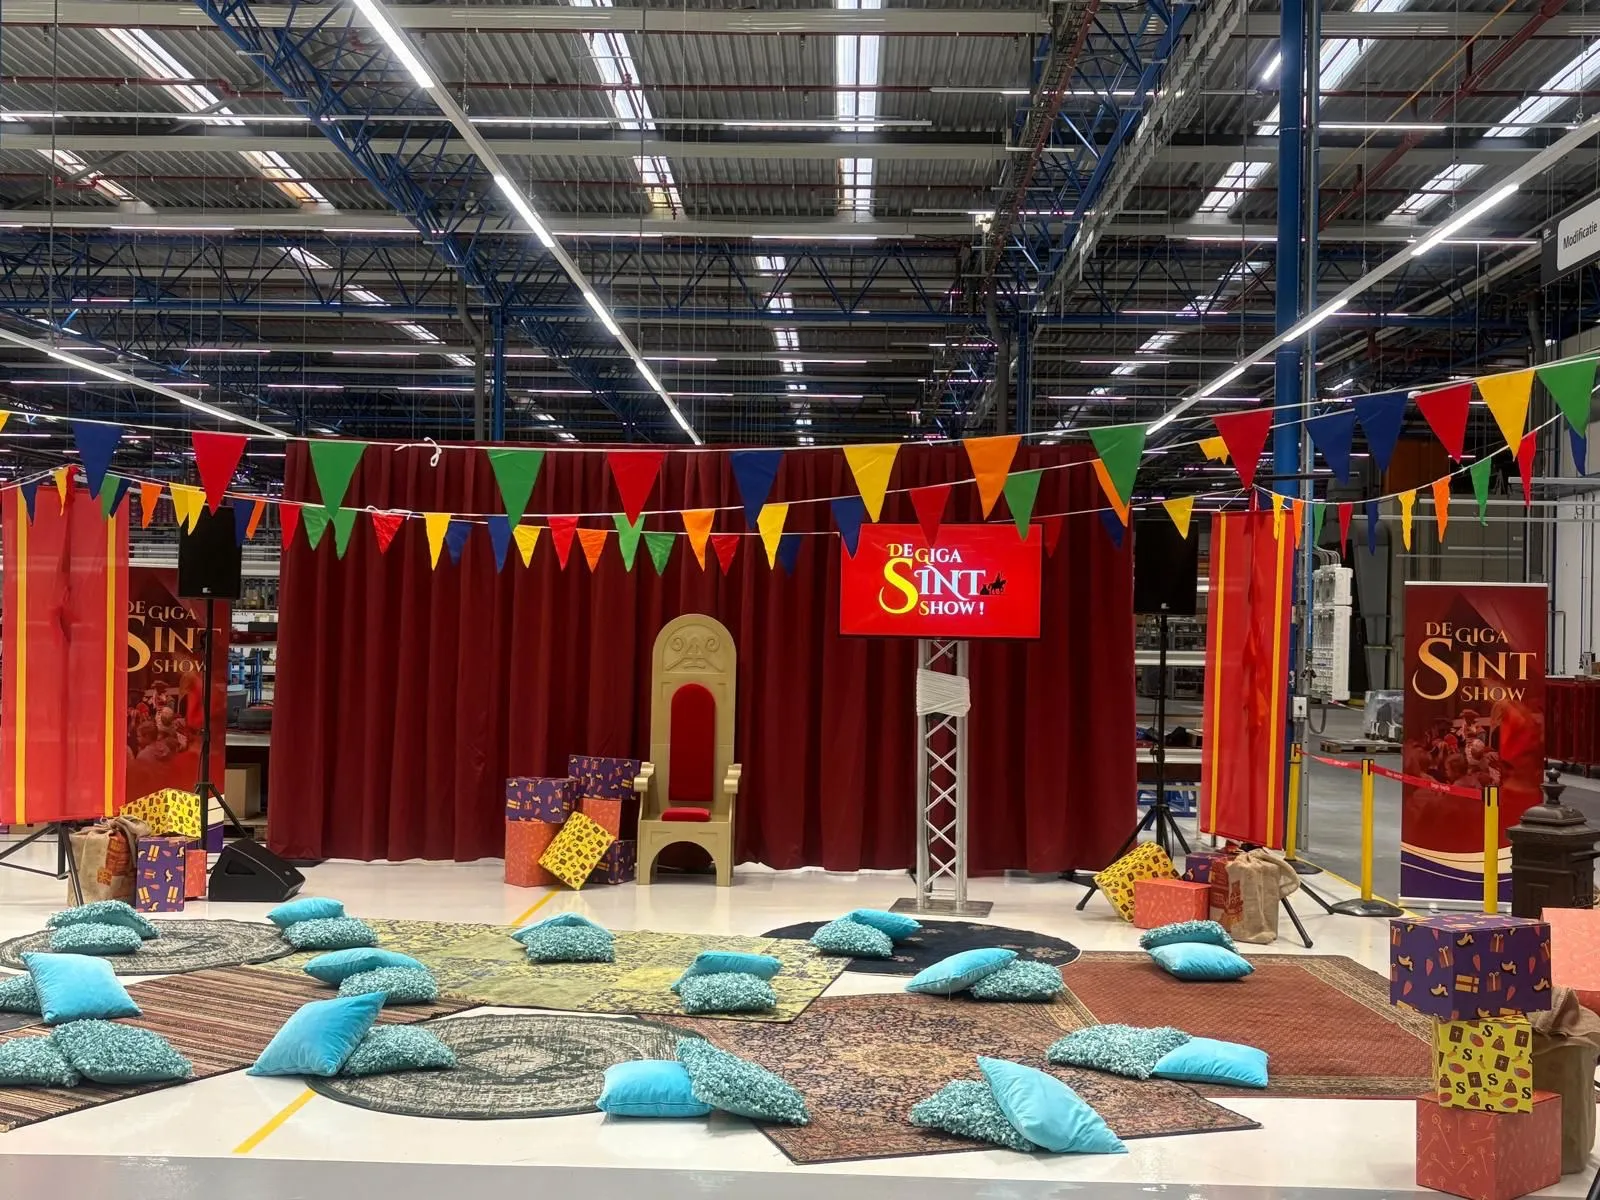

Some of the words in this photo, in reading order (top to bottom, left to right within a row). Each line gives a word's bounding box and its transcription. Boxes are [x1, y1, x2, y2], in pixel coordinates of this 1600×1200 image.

[1563, 221, 1597, 250] Modificatie
[886, 543, 913, 557] DE
[915, 548, 963, 566] GIGA
[879, 557, 986, 614] SINT
[148, 606, 197, 622] GIGA
[1425, 621, 1453, 637] DE
[1455, 627, 1509, 646] GIGA
[1412, 637, 1537, 700] SINT
[1461, 685, 1526, 702] SHOW
[1482, 1024, 1493, 1038] S
[1462, 1048, 1473, 1061] S
[1487, 1073, 1499, 1086] S
[1455, 1082, 1466, 1094] S
[1521, 1087, 1531, 1100] S
